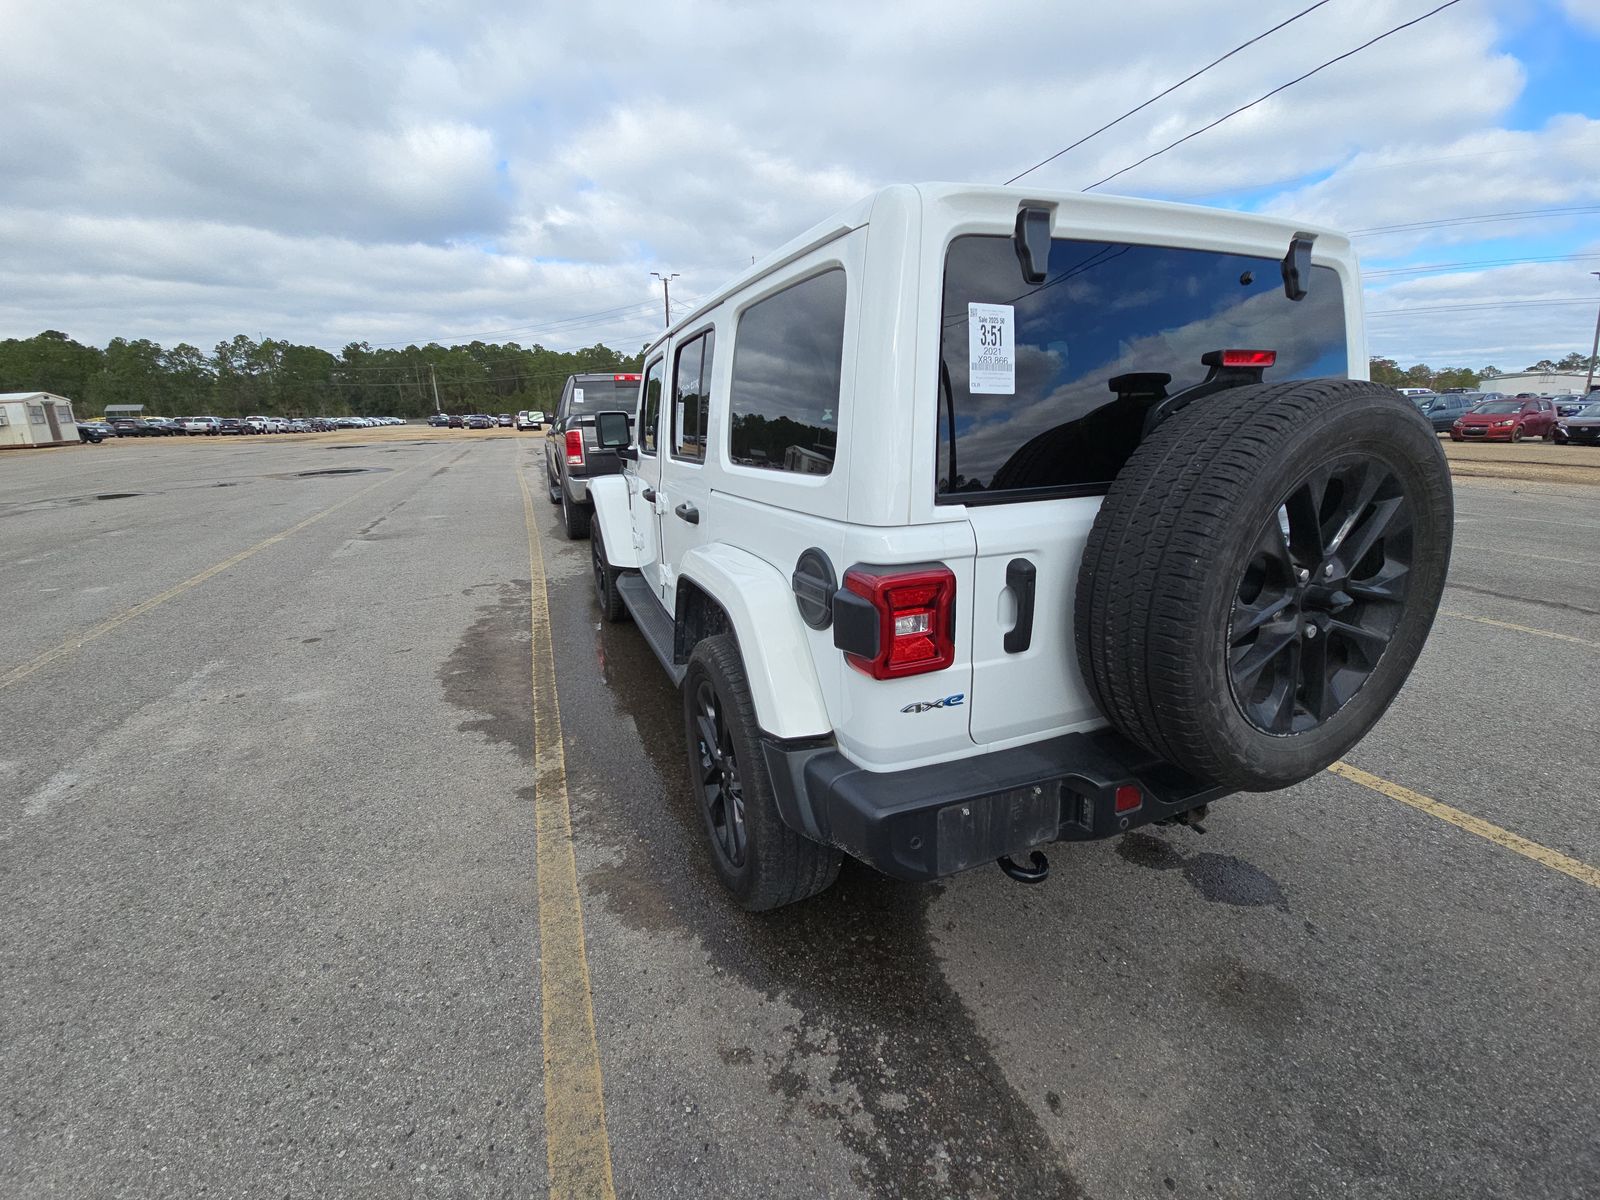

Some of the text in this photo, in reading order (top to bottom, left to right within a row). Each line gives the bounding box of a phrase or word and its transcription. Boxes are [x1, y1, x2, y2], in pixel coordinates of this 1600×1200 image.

[980, 324, 1002, 346] 3:51
[984, 347, 1002, 356] 2021
[978, 356, 992, 364] X83
